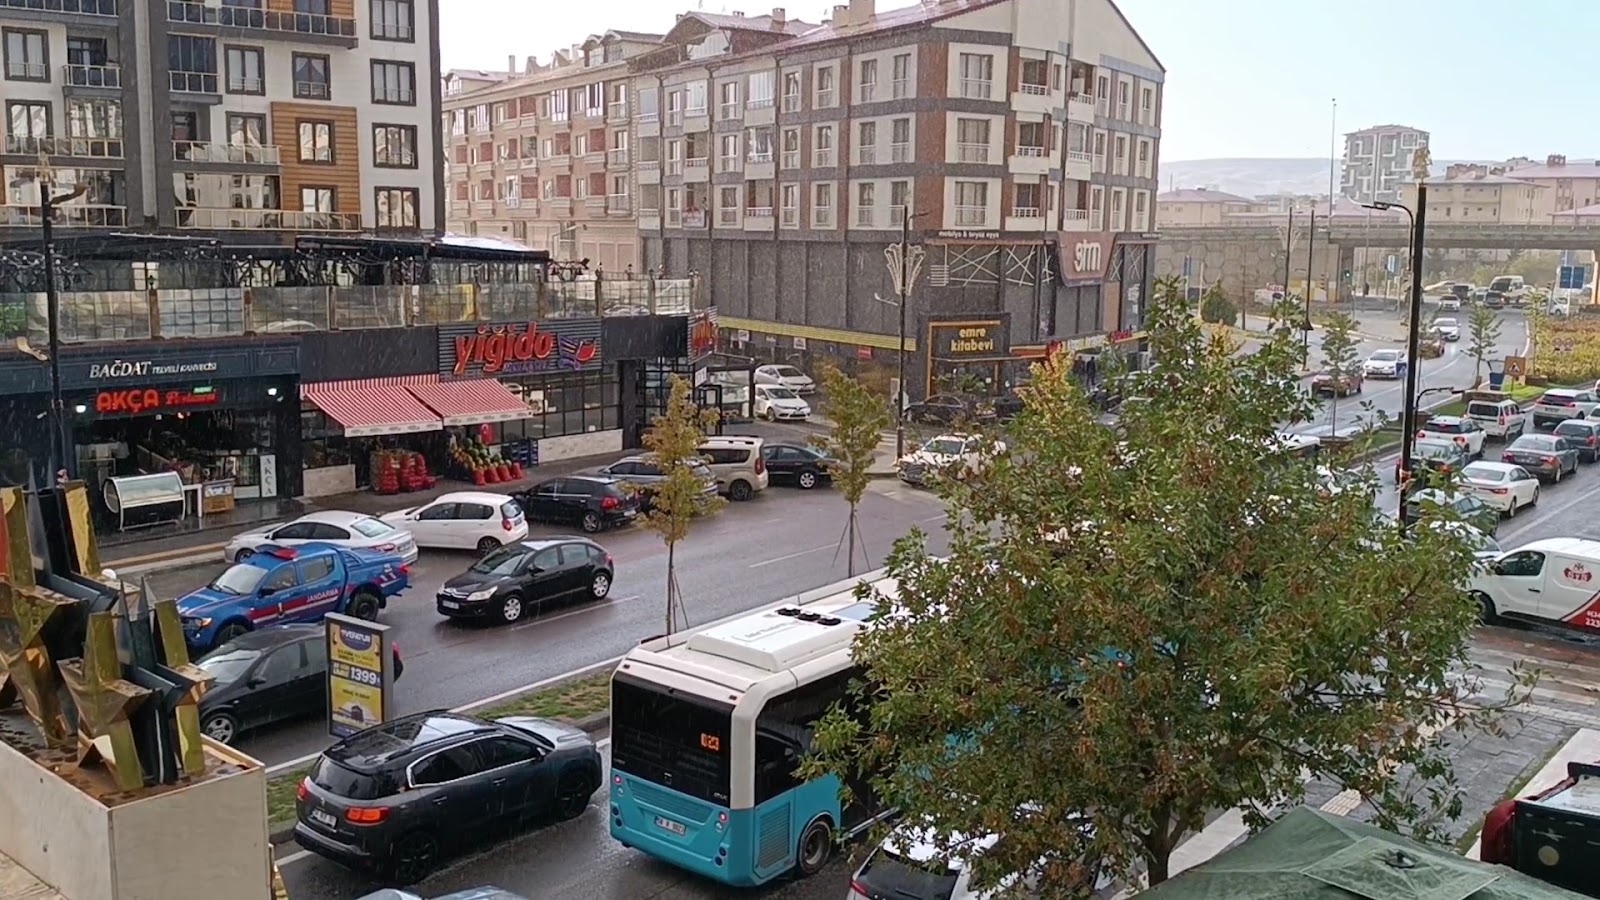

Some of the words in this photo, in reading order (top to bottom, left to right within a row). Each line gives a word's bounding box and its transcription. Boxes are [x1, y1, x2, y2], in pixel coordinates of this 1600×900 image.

[959, 328, 986, 338] emre
[454, 321, 554, 376] yiğido
[951, 338, 994, 351] kitabevi
[89, 360, 152, 379] BAĞDAT
[96, 389, 159, 413] AKÇA
[306, 588, 339, 603] JANDARMA
[350, 666, 377, 685] 1399
